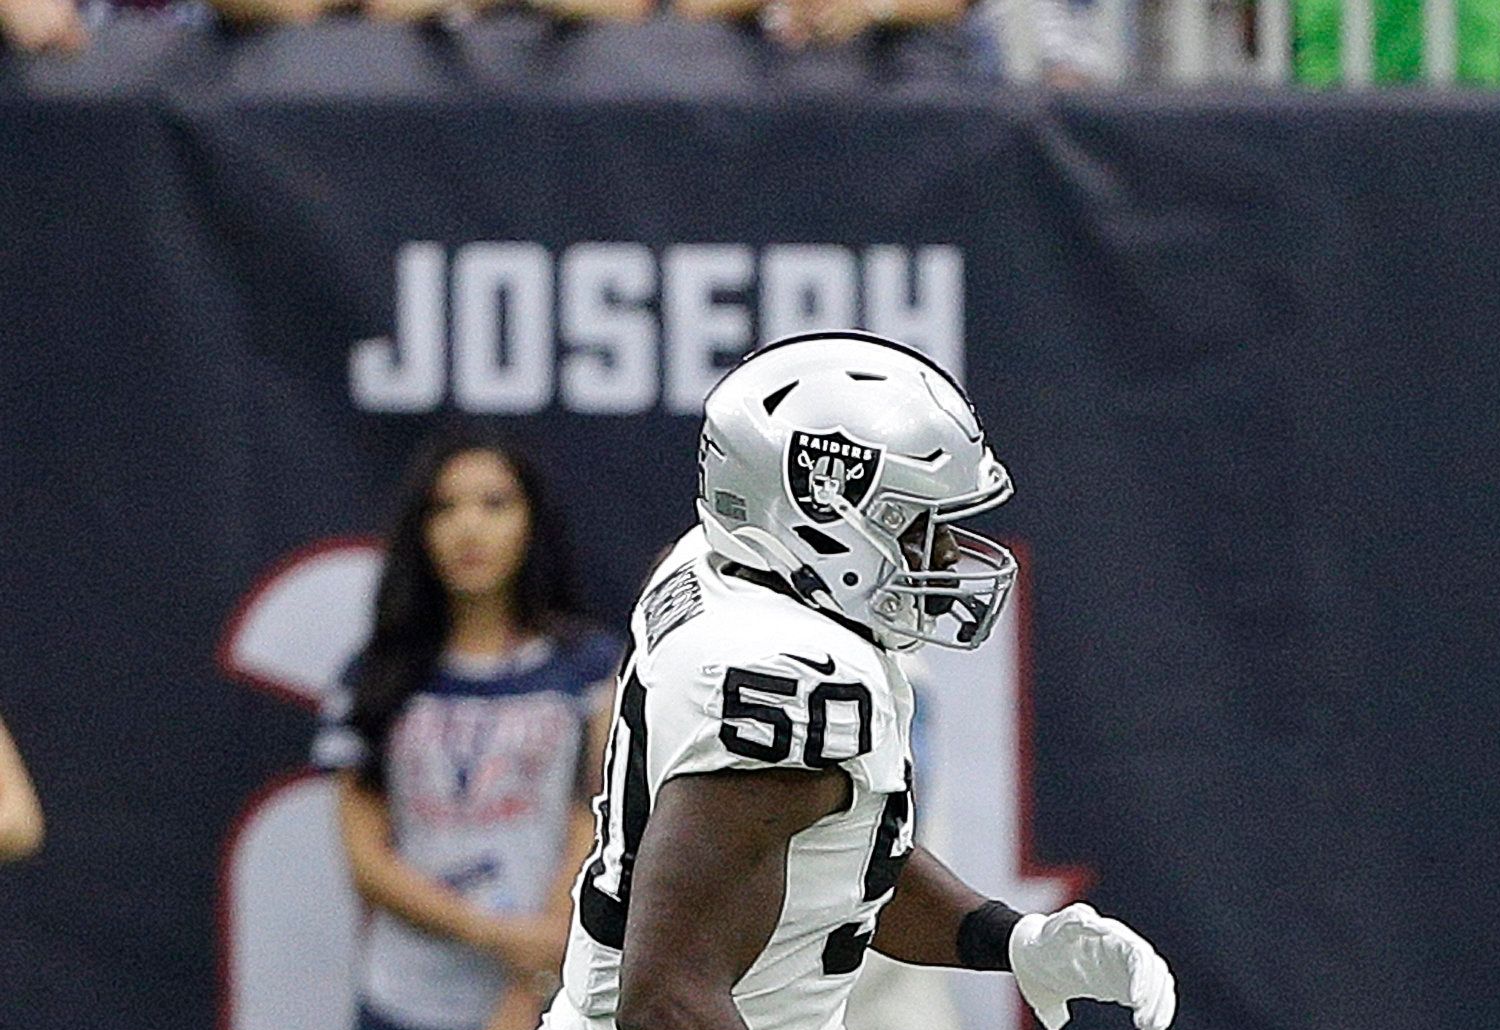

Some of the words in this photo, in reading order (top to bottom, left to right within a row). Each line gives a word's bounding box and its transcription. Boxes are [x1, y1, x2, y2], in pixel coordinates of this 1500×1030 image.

[349, 241, 964, 413] JOSEPH
[799, 434, 873, 461] RAIDERS
[718, 667, 873, 769] 50
